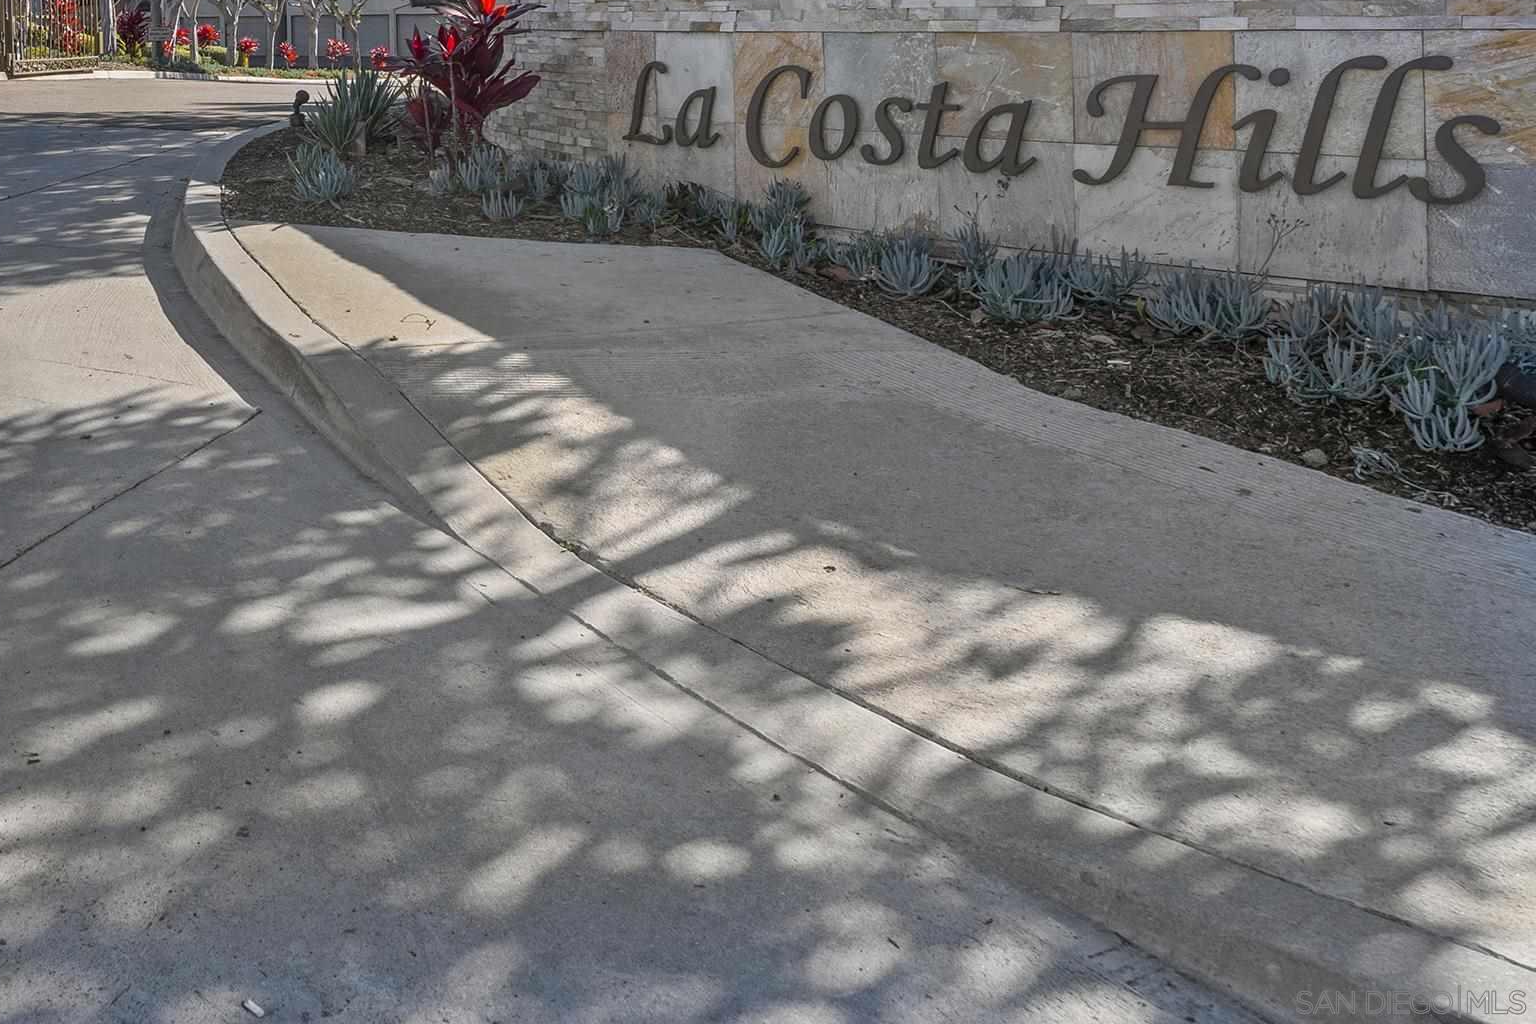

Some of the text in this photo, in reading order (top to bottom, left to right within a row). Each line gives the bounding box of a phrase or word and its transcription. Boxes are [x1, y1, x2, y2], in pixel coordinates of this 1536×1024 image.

[623, 55, 1502, 206] La Costa Hills
